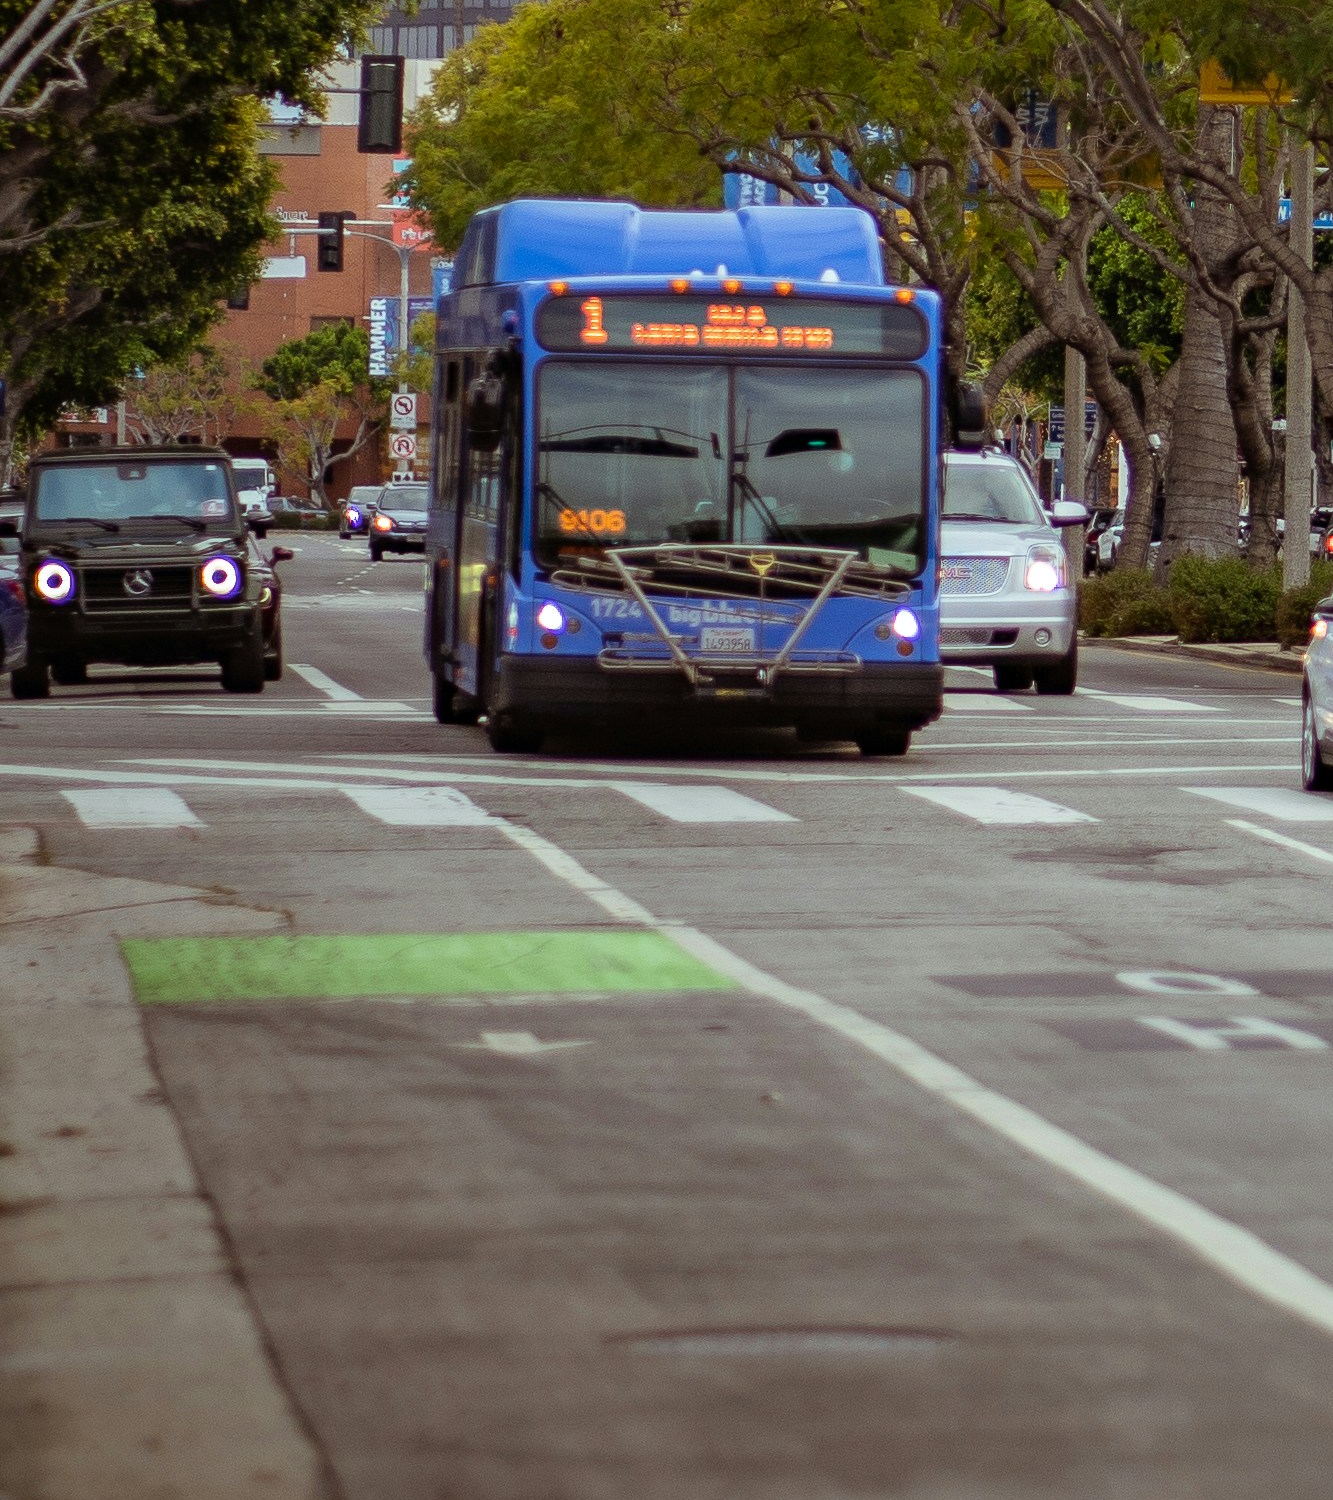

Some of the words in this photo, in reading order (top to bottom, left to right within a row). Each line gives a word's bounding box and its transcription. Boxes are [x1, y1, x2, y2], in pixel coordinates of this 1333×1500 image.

[581, 297, 608, 343] 1
[369, 298, 387, 376] HAMMER
[940, 567, 973, 579] MC
[590, 598, 642, 619] 1724
